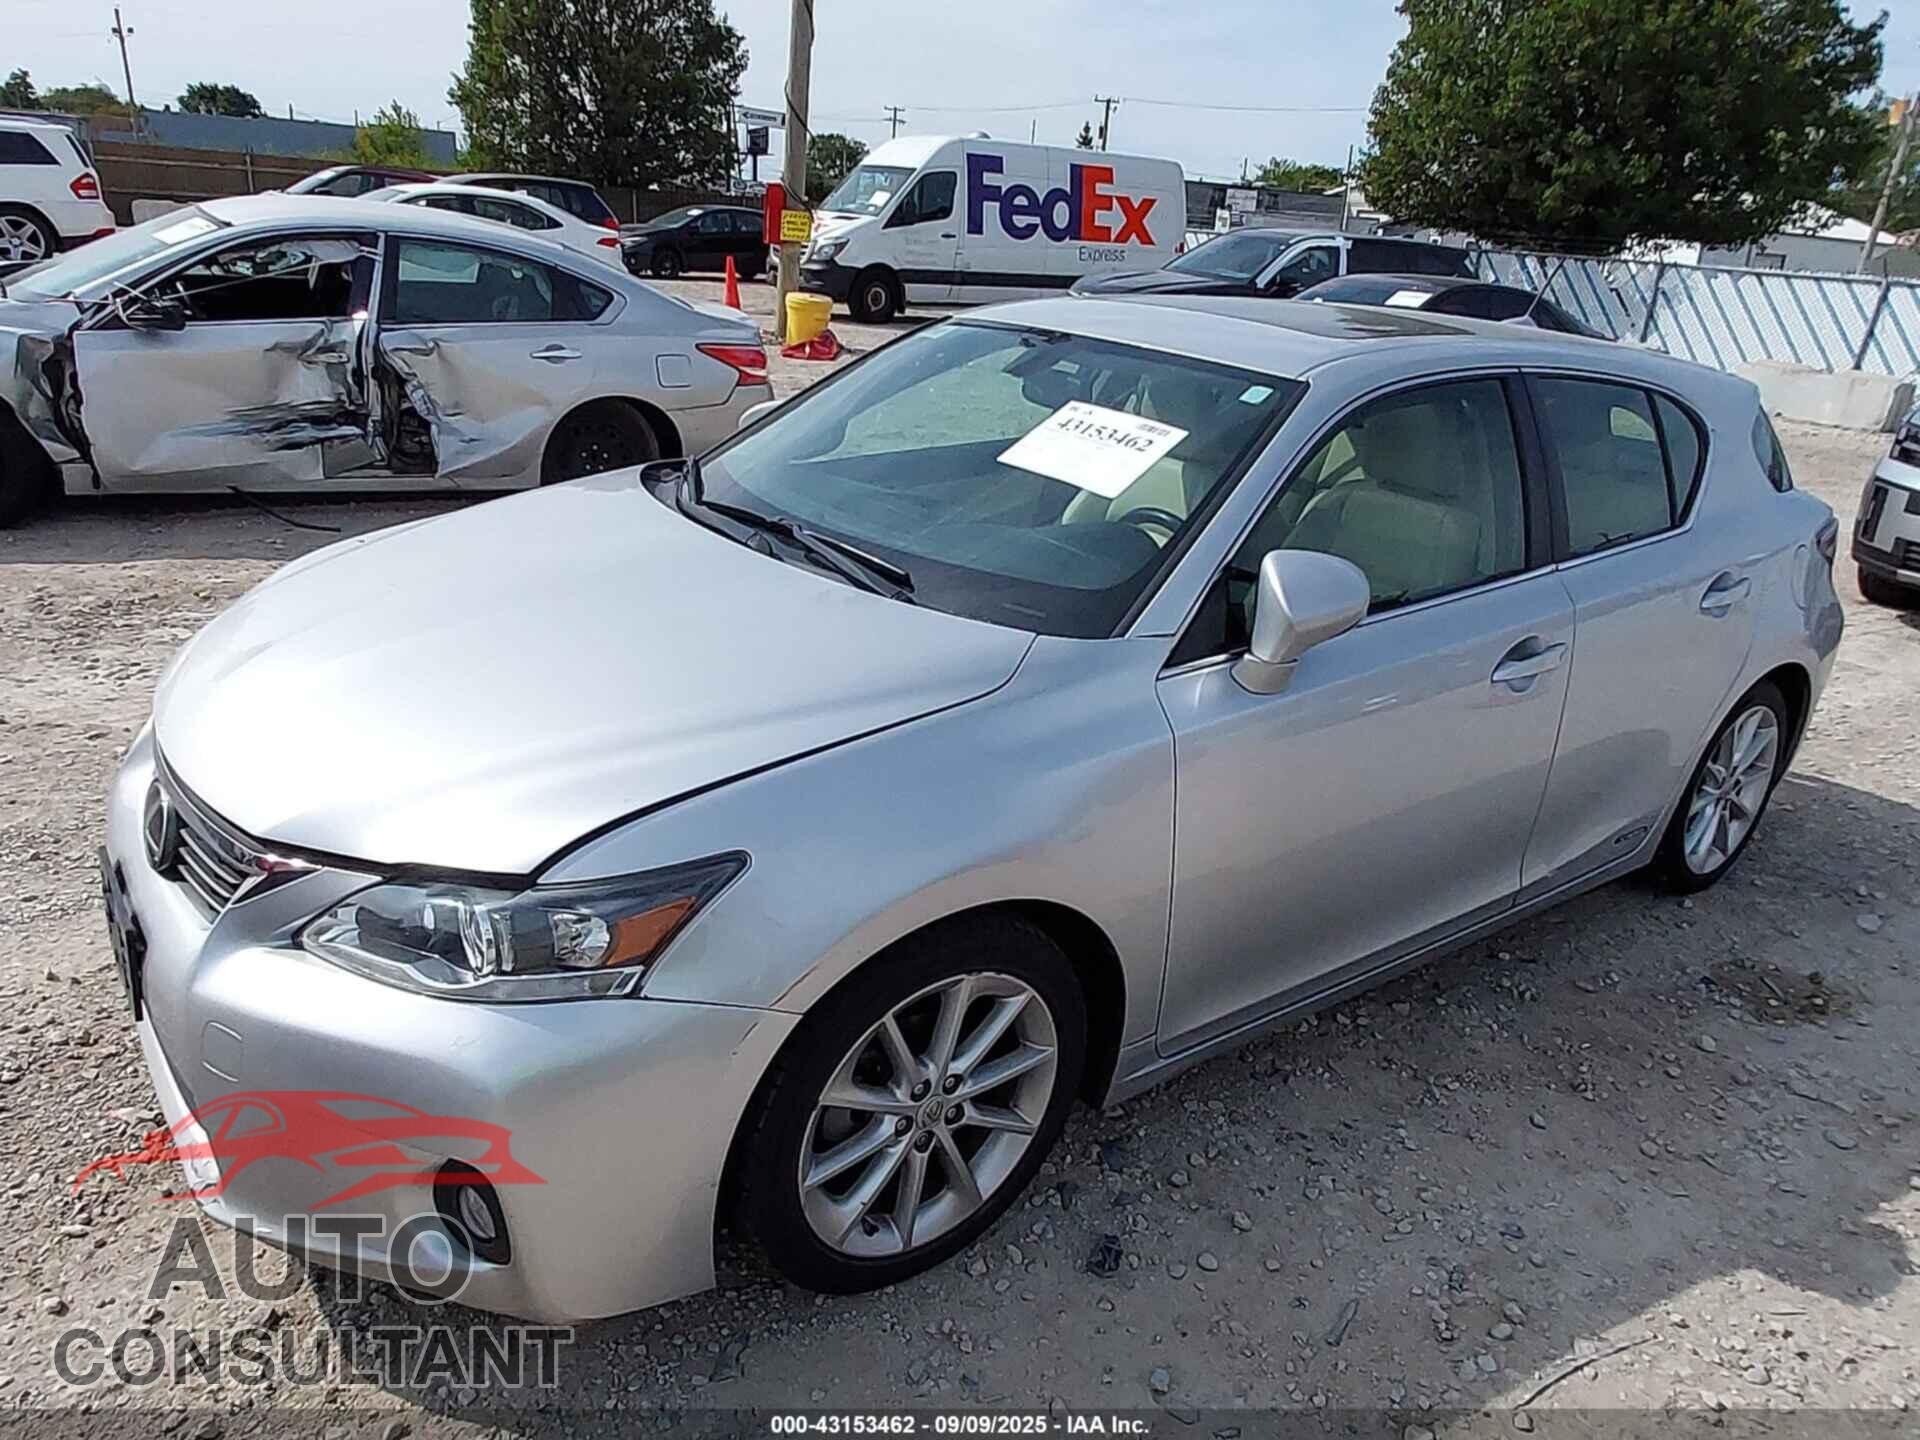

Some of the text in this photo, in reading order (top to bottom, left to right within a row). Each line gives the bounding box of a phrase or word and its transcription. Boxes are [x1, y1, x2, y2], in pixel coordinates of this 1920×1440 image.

[966, 153, 1157, 246] FedEx
[1079, 246, 1127, 262] Express
[1057, 417, 1153, 452] 43153462
